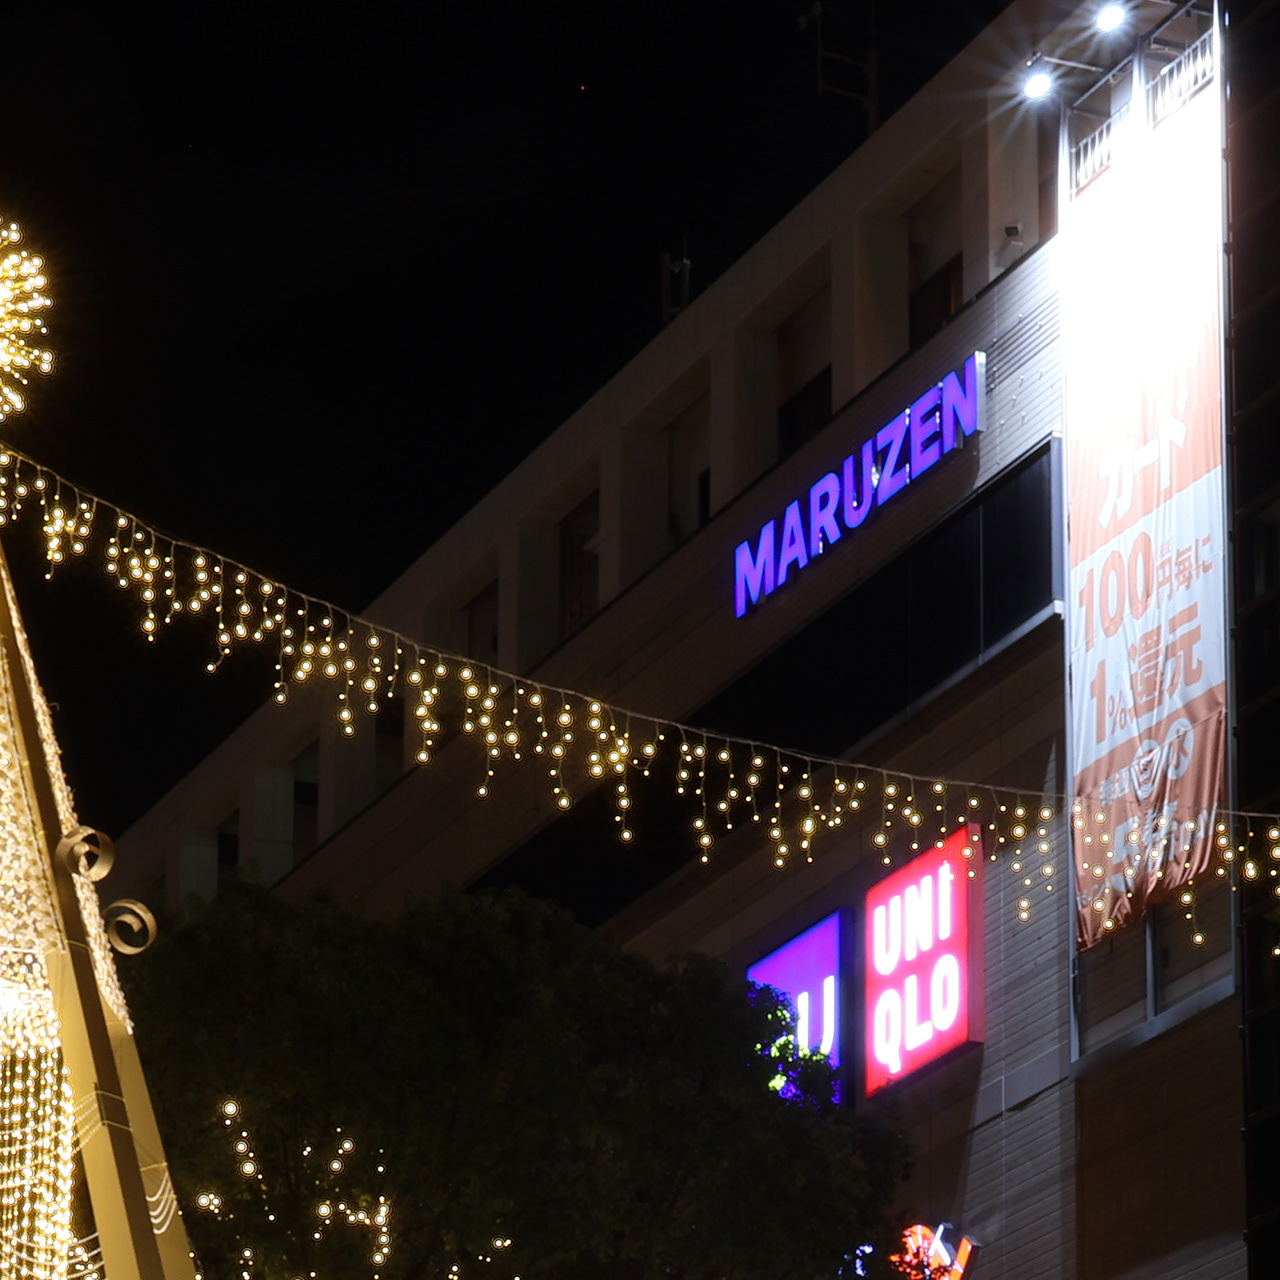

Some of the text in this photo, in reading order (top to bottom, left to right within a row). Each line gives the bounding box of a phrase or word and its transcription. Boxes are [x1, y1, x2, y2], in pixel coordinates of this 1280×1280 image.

[735, 353, 977, 619] MARUZEN
[874, 863, 951, 975] UNI
[874, 954, 959, 1074] QLO
